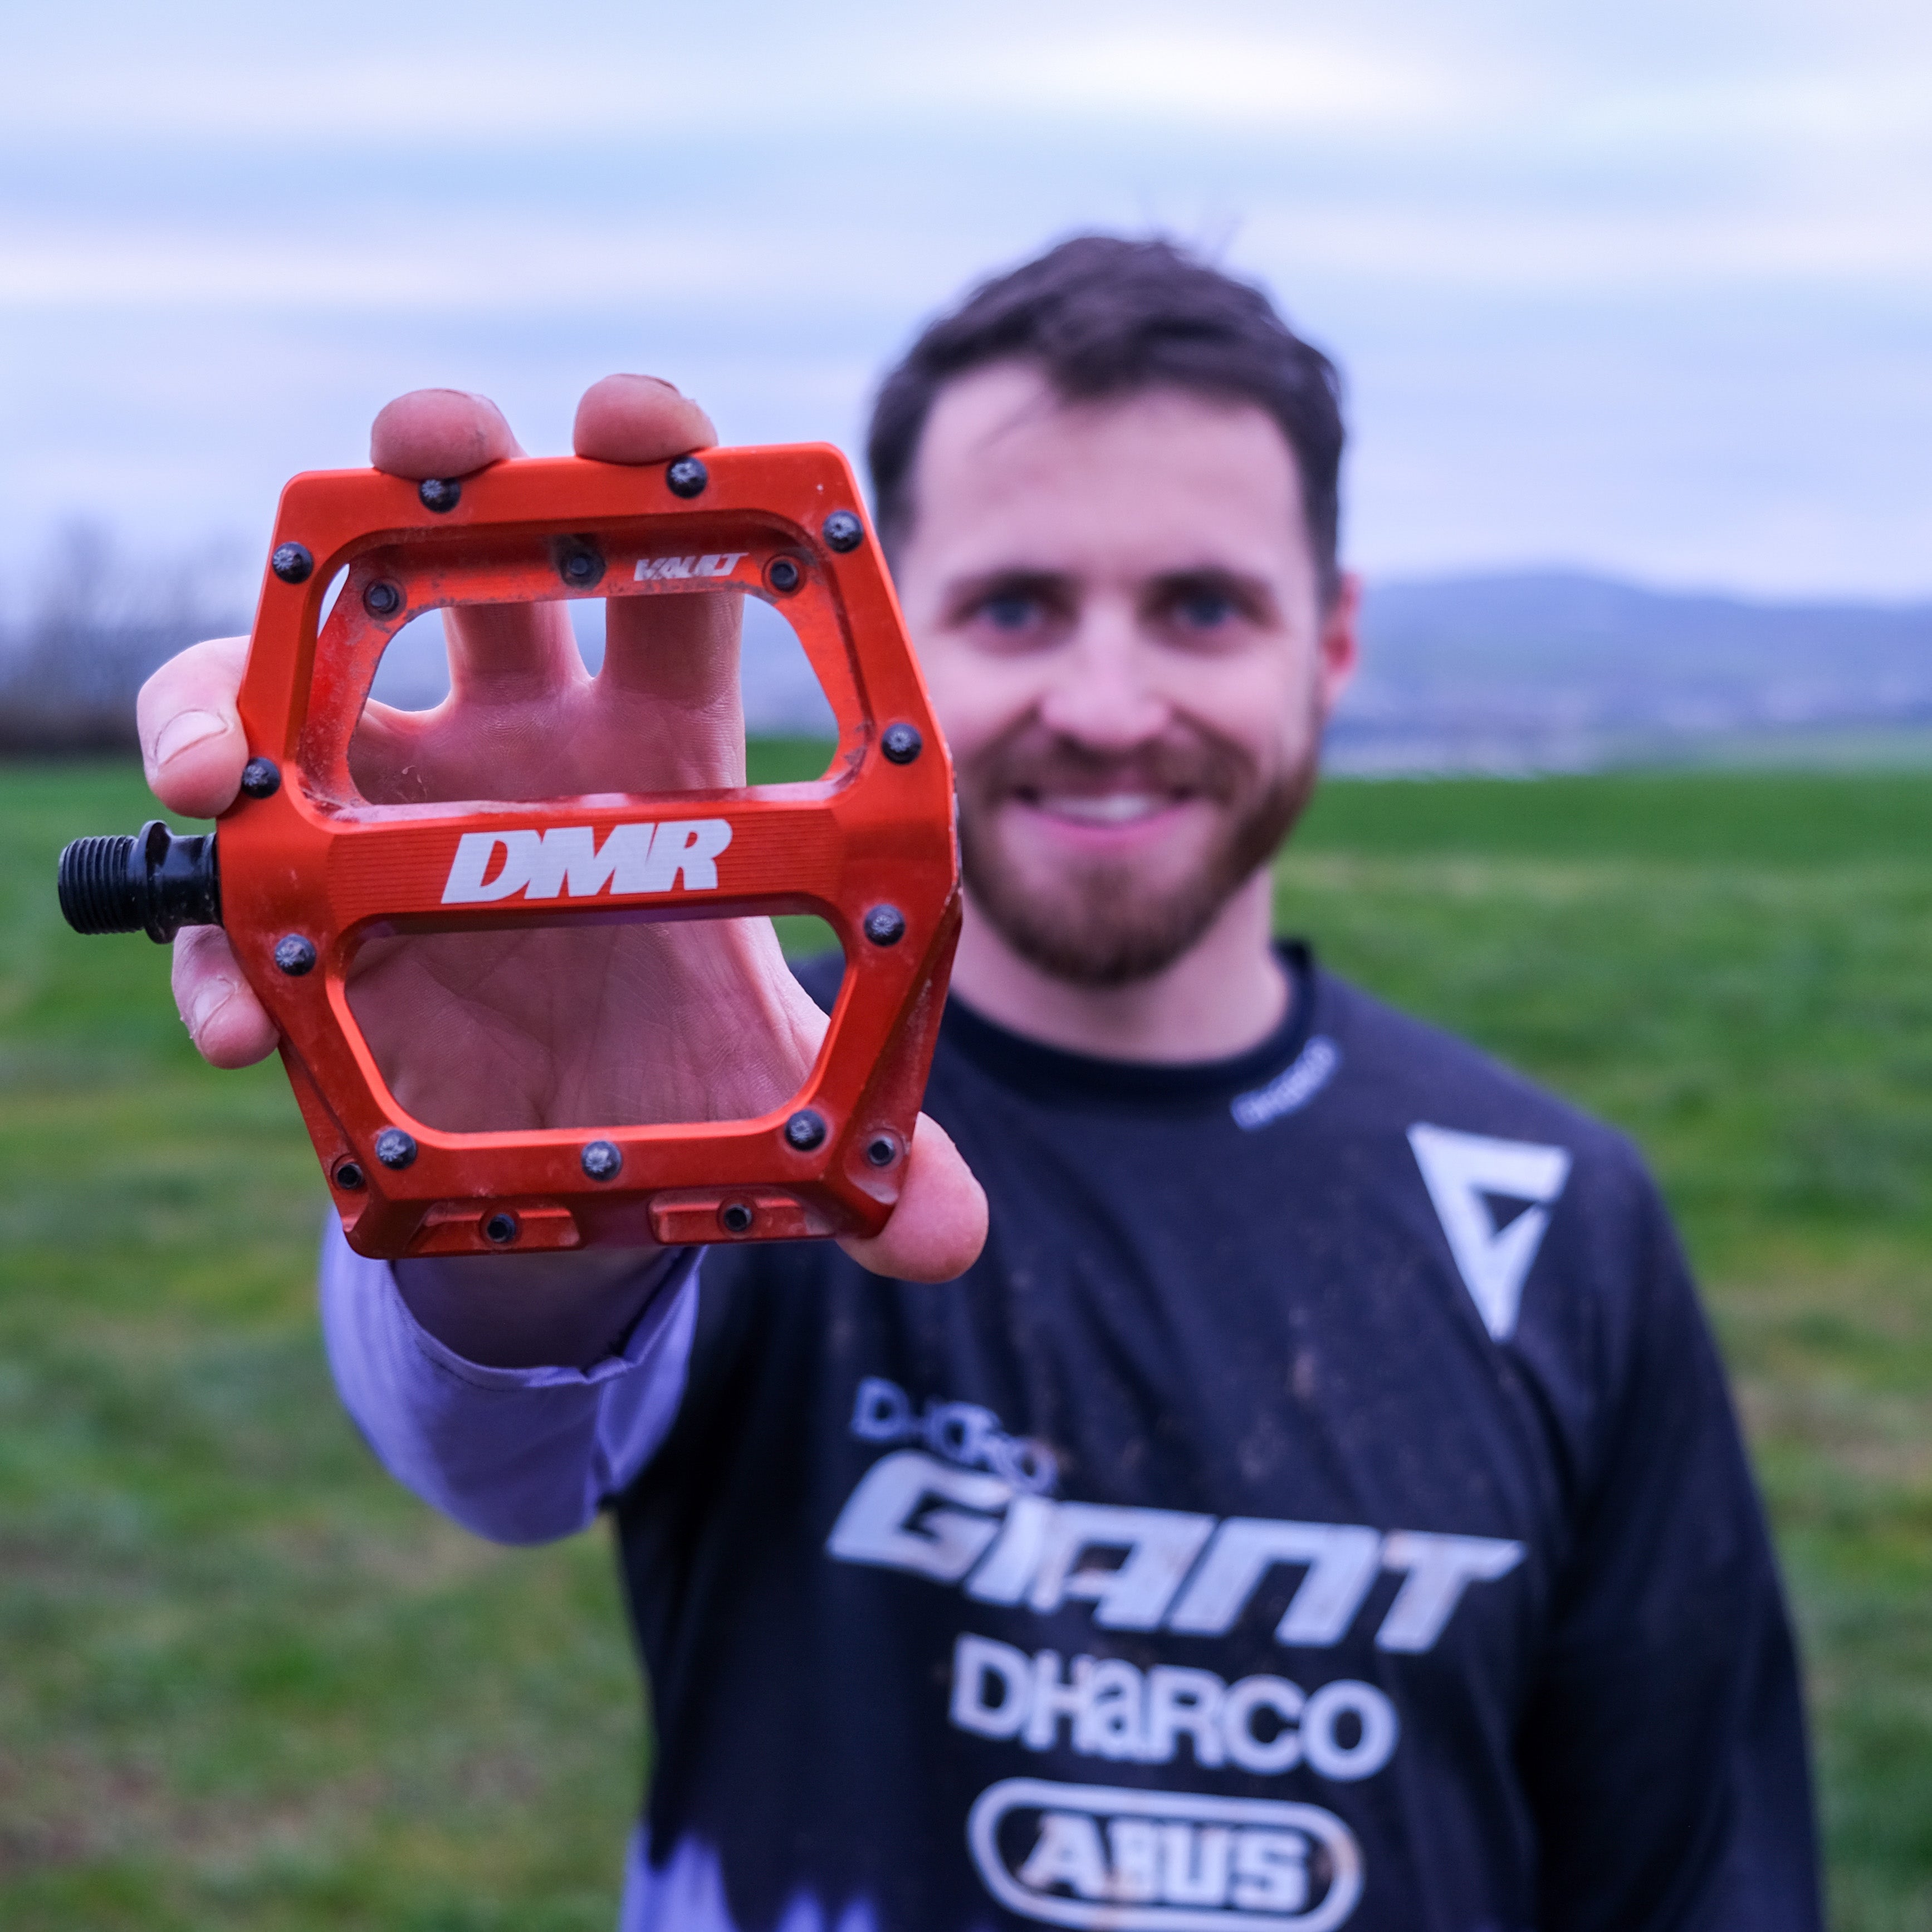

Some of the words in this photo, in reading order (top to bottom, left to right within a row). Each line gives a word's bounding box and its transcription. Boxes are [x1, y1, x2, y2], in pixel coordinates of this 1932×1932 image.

[633, 552, 748, 581] VAULT
[441, 819, 733, 904] DMR
[826, 1451, 1527, 1653] GIANT
